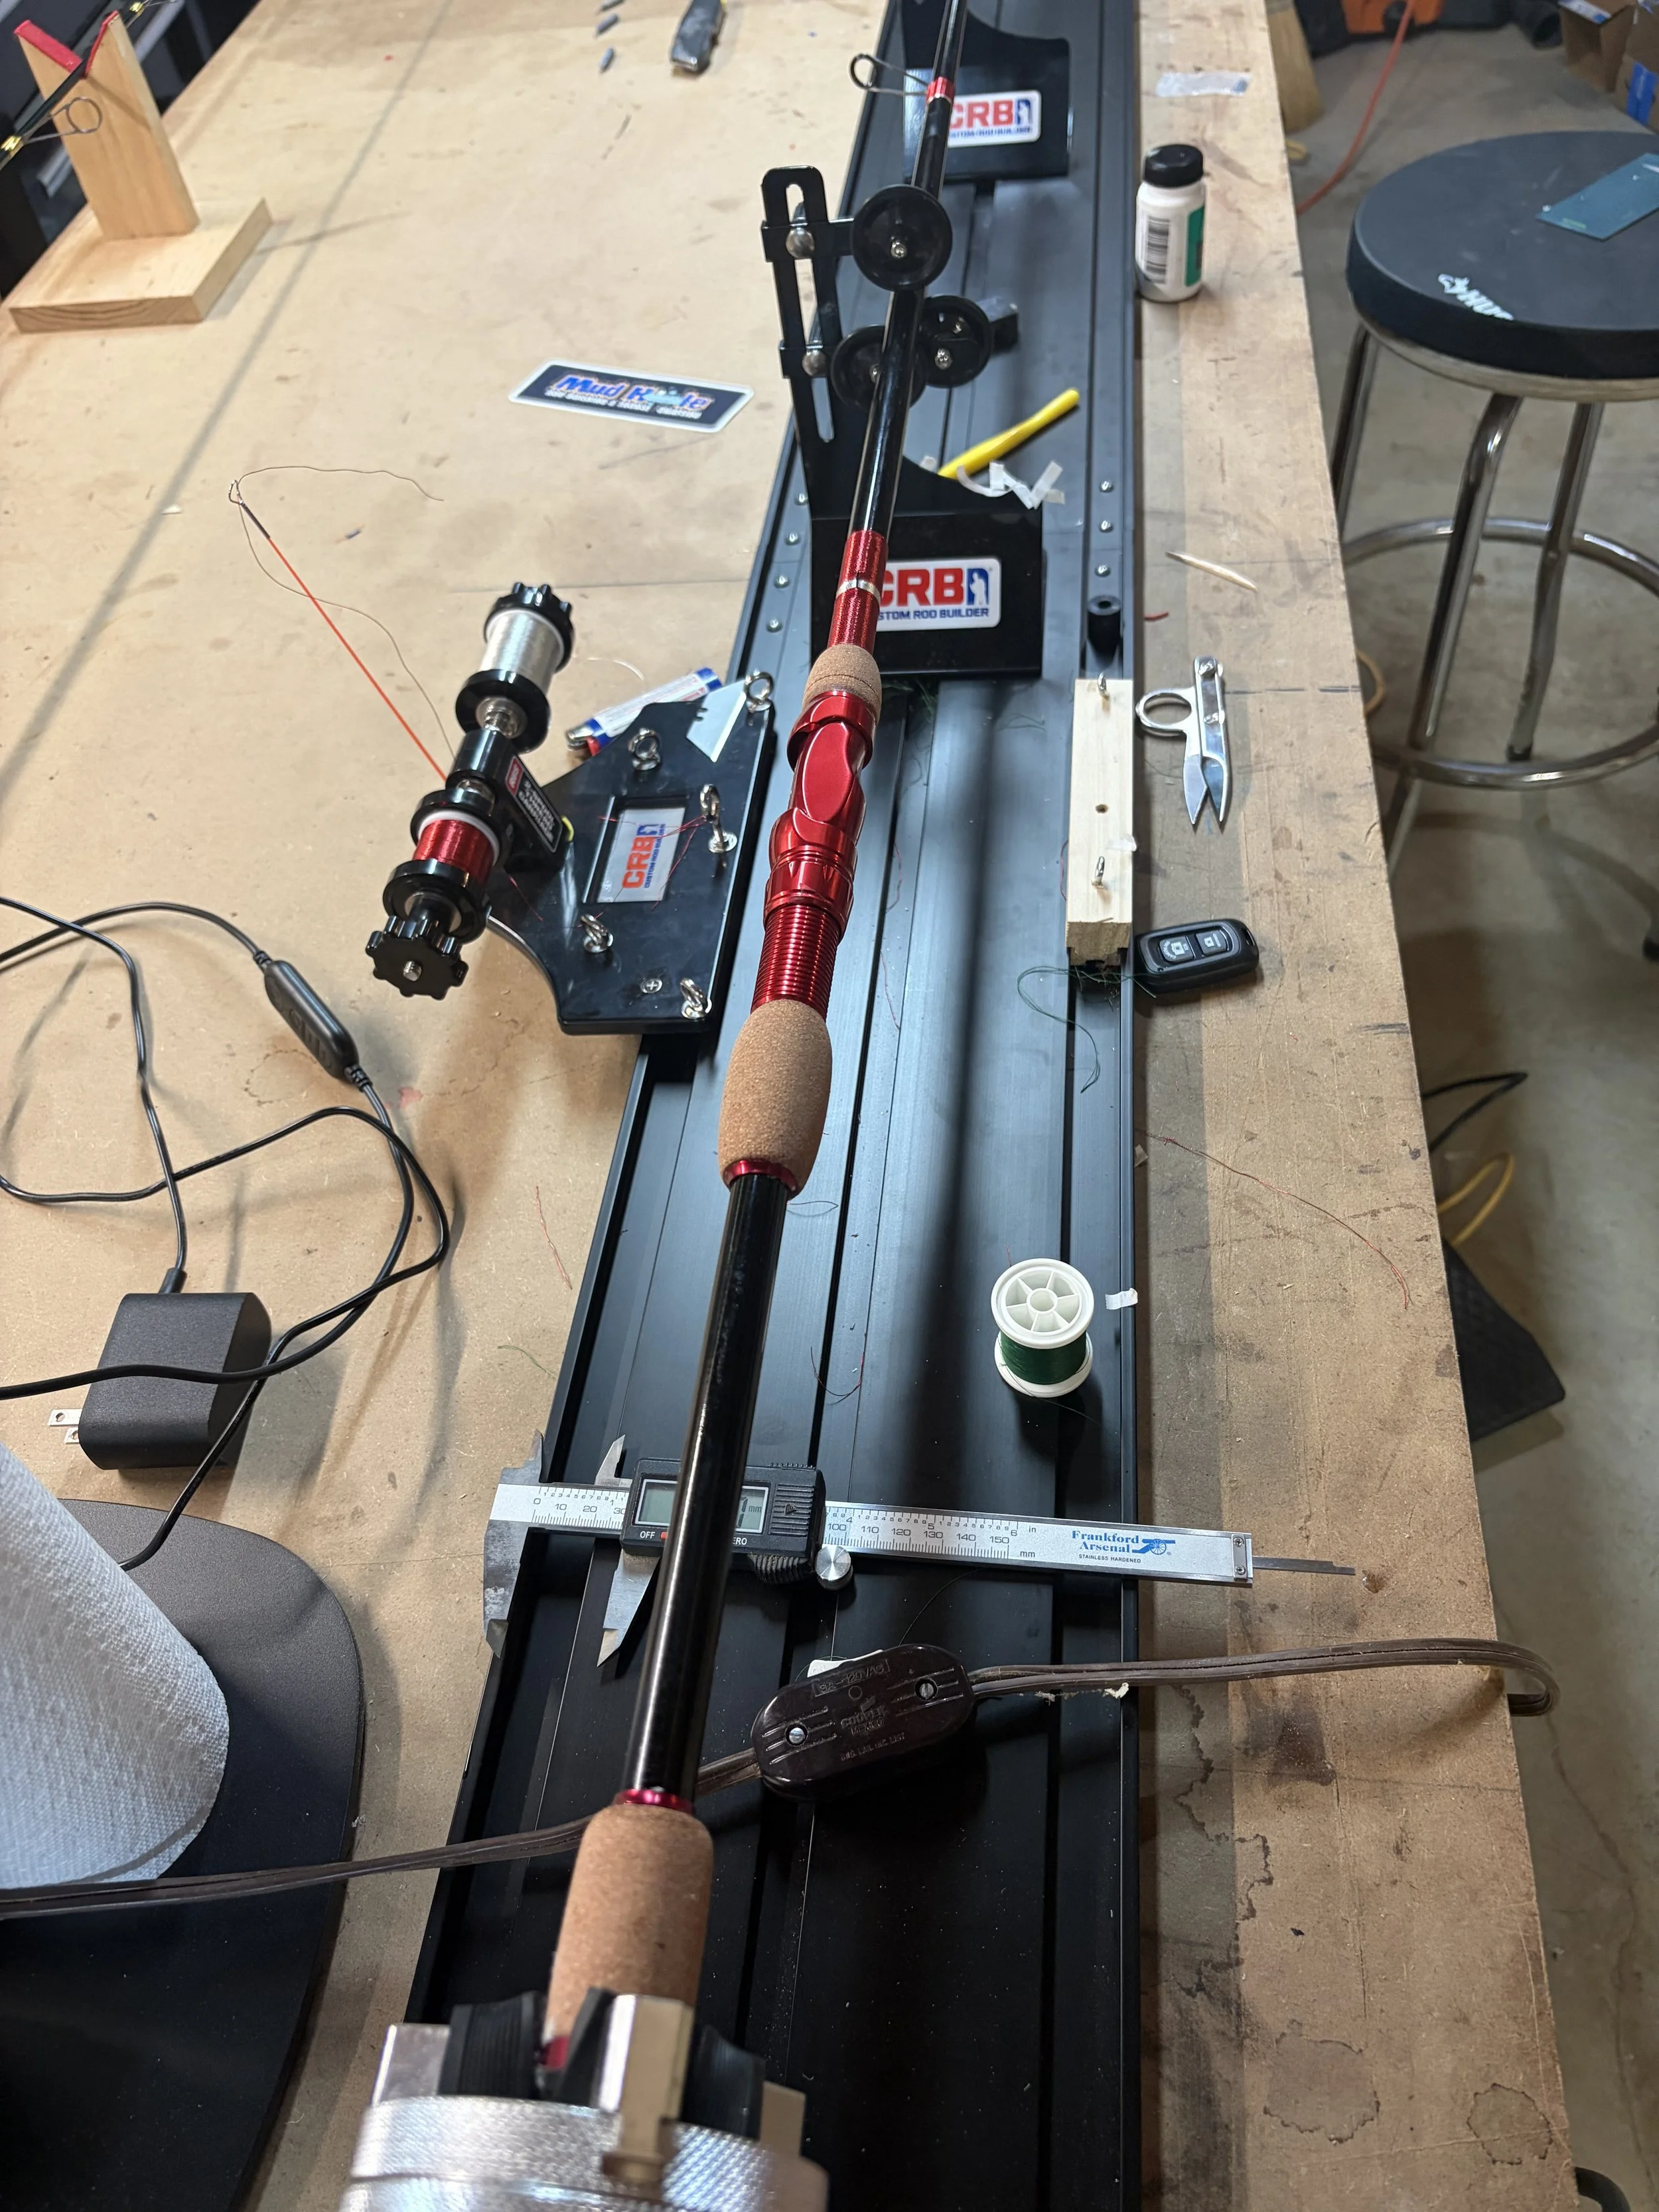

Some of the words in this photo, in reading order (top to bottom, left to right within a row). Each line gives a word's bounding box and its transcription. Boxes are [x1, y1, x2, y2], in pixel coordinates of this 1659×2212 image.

[556, 376, 626, 398] Mud
[877, 610, 910, 621] STOM
[913, 609, 937, 620] ROD
[940, 607, 989, 619] BUILDER
[622, 836, 656, 888] CRB
[644, 862, 656, 888] CUSTOM
[650, 849, 660, 861] ROD
[891, 1528, 911, 1536] 120
[1072, 1530, 1139, 1544] Frankford
[1079, 1541, 1130, 1553] Arsenal
